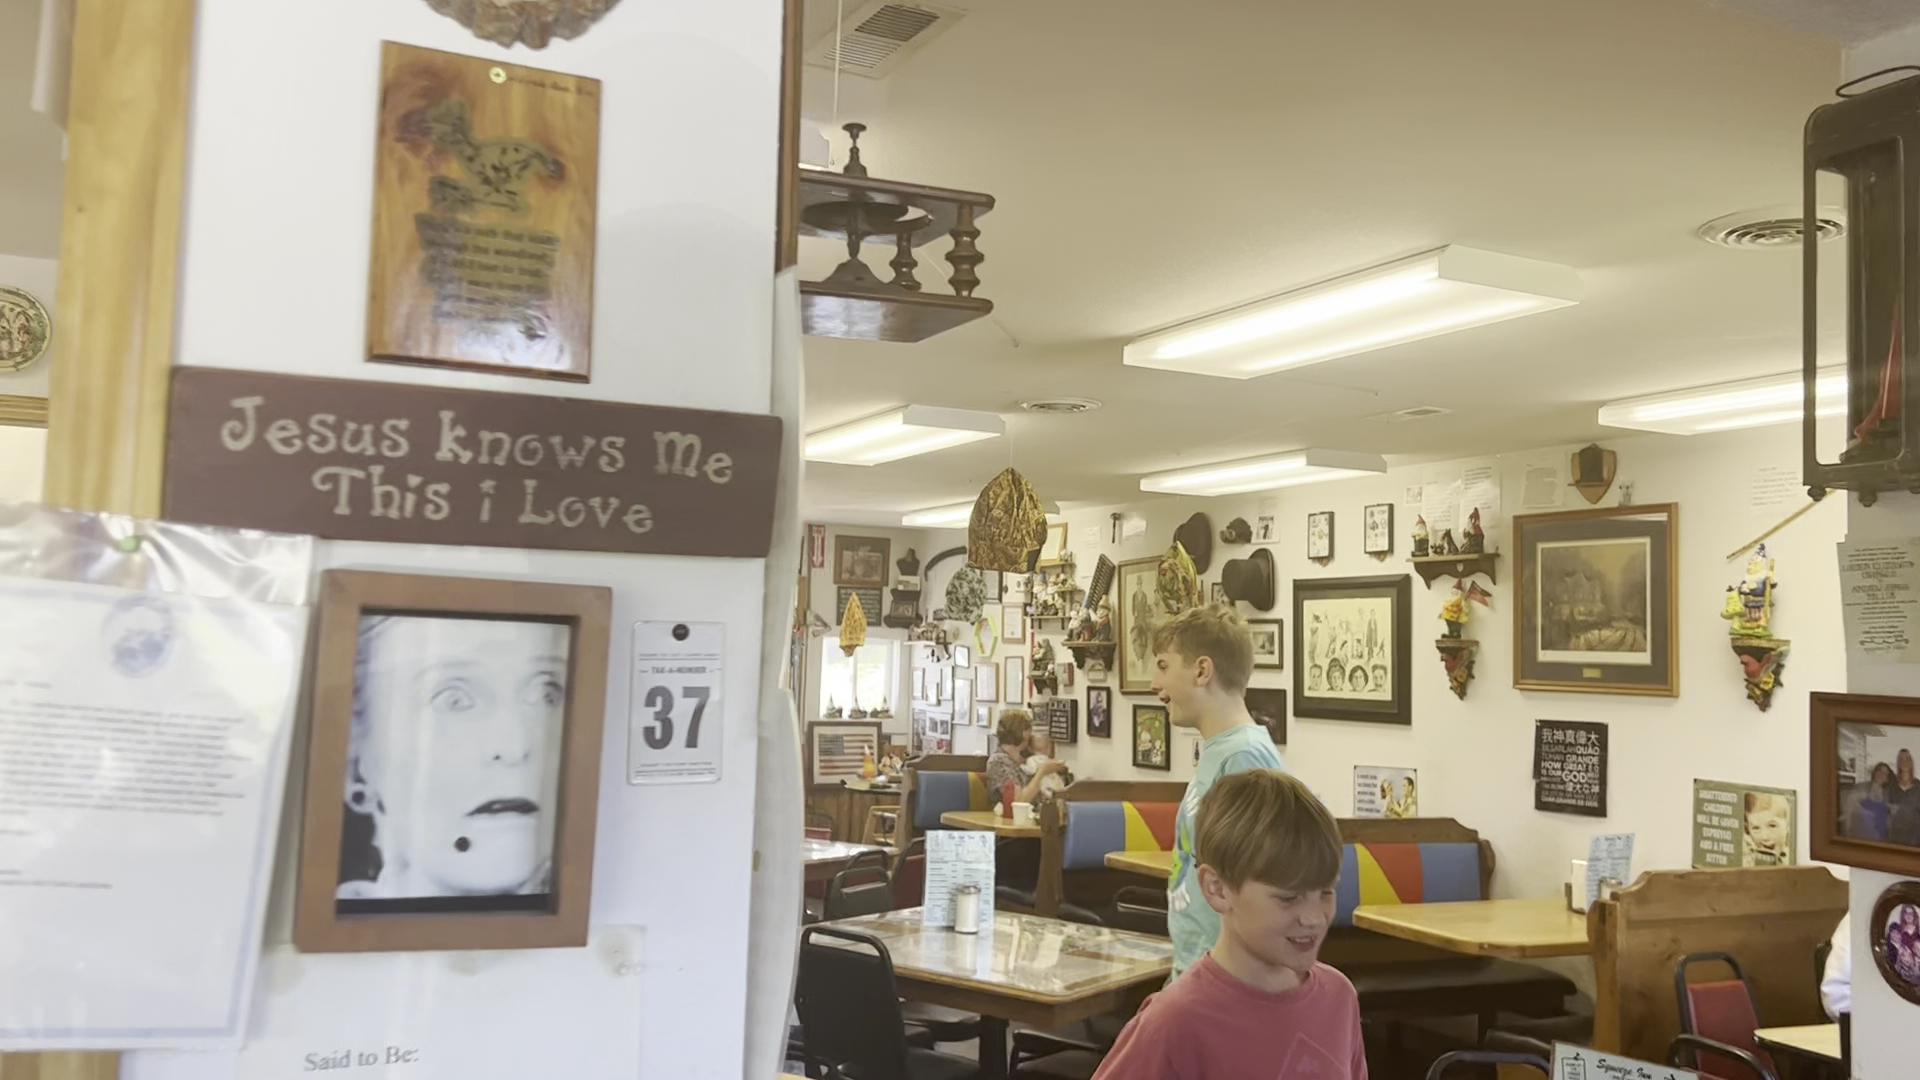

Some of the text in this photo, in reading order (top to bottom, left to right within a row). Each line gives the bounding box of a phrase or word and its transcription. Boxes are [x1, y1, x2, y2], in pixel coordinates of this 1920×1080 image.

[221, 395, 410, 458] Jesus
[435, 410, 626, 473] knows
[312, 465, 654, 534] This i Love
[642, 685, 711, 751] 37
[1541, 761, 1587, 772] HOW GREAT
[1565, 754, 1599, 765] GRANDE
[1562, 771, 1587, 783] GOD
[304, 1049, 352, 1072] Said
[357, 1052, 379, 1067] to
